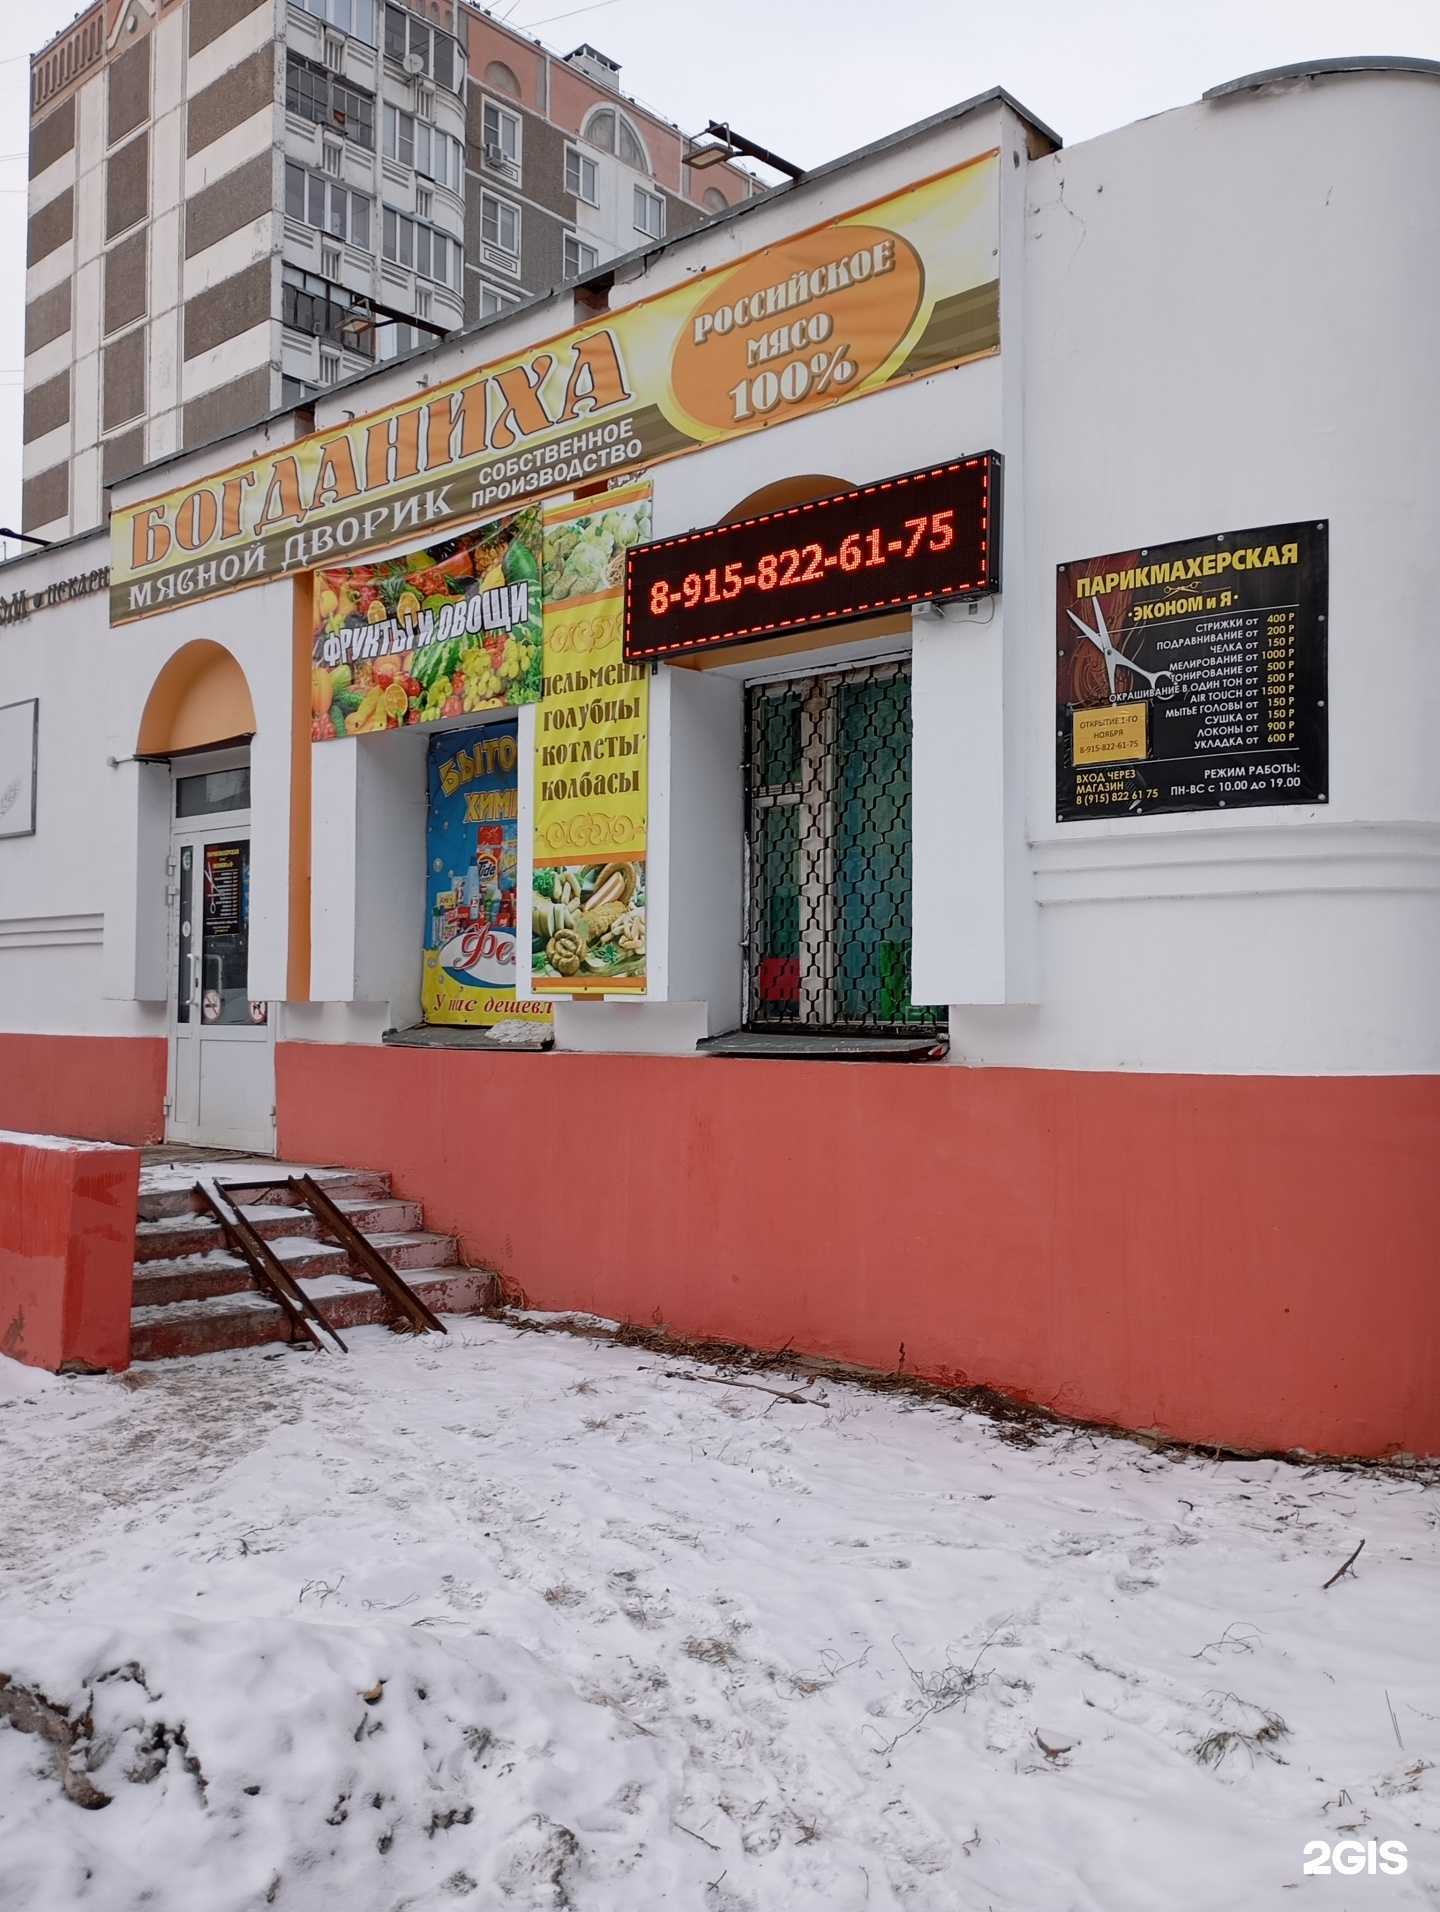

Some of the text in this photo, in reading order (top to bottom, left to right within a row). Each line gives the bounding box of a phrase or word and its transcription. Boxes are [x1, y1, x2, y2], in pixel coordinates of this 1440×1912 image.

[693, 239, 896, 346] РОССИЙСКОЕ
[746, 312, 833, 368] МЯСО
[728, 344, 858, 423] 100%
[130, 328, 633, 570] БОГДАНИХА
[478, 417, 634, 486] СОБСТВЕННОЕ
[471, 438, 643, 509] ПРОИЗВОДСТВО
[128, 483, 455, 612] МЯСНОЙ ДВОРИК
[650, 510, 954, 615] 8-915-822-61-75
[1076, 543, 1298, 599] ПАРИКМАХЕРСКАЯ
[1133, 591, 1232, 622] ЭКОНОМ и Я
[323, 581, 529, 667] ФРУКТЫ И ОВОЩИ
[1195, 619, 1243, 633] СТРИЖКИ
[1245, 618, 1259, 626] от
[1267, 613, 1286, 623] 400
[1157, 631, 1243, 650] ПОДРАВНИВАНИЕ
[1245, 630, 1259, 638] от
[1267, 625, 1286, 635] 200
[1210, 643, 1243, 654] ЧЕЛКА
[1268, 637, 1286, 647] 150
[1169, 655, 1243, 671] МЕЛИРОВАНИЕ
[1262, 649, 1286, 659] 1000
[1170, 666, 1243, 683] ТОНИРОВАНИЕ
[1245, 665, 1259, 673] от
[1267, 661, 1286, 671] 500
[1109, 685, 1180, 702] ОКРАШИВАНИЕ
[1190, 681, 1220, 692] ОДИН
[1223, 678, 1242, 688] ТОН
[1245, 677, 1259, 685] от
[1266, 673, 1286, 683] 500
[1190, 693, 1205, 703] AIR
[1207, 690, 1242, 701] TOUCH
[1245, 689, 1259, 697] от
[1261, 685, 1286, 695] 1500
[543, 697, 640, 731] голубцы
[1165, 706, 1197, 718] МЫТЬЕ
[1199, 701, 1242, 714] ГОЛОВЫ
[1245, 701, 1259, 709] от
[1267, 697, 1286, 707] 150
[1205, 713, 1242, 725] СУШКА
[1245, 713, 1259, 721] от
[1267, 709, 1286, 719] 150
[1080, 718, 1118, 729] ОТКРЫТИЕ
[1093, 729, 1124, 739] НОЯБРЯ
[1197, 726, 1242, 737] ЛОКОНЫ
[1245, 725, 1259, 733] от
[1267, 721, 1286, 731] 900
[542, 734, 640, 767] котлеты
[1080, 740, 1139, 753] 8-915-822-61-75
[1194, 737, 1242, 750] УКЛАДКА
[1245, 737, 1259, 745] от
[1267, 733, 1286, 743] 600
[1076, 769, 1136, 784] ВХОД ЧЕРЕЗ
[1204, 763, 1301, 779] РЕЖИМ РАБОТЫ:
[541, 770, 640, 801] колбасы
[1076, 781, 1124, 794] МАГАЗИН
[1171, 784, 1205, 796] ПН-ВС
[1219, 780, 1248, 791] 10.00
[1250, 781, 1266, 790] до
[1270, 777, 1301, 788] 19.00
[1076, 788, 1159, 806] 8 (915) 822 61 75
